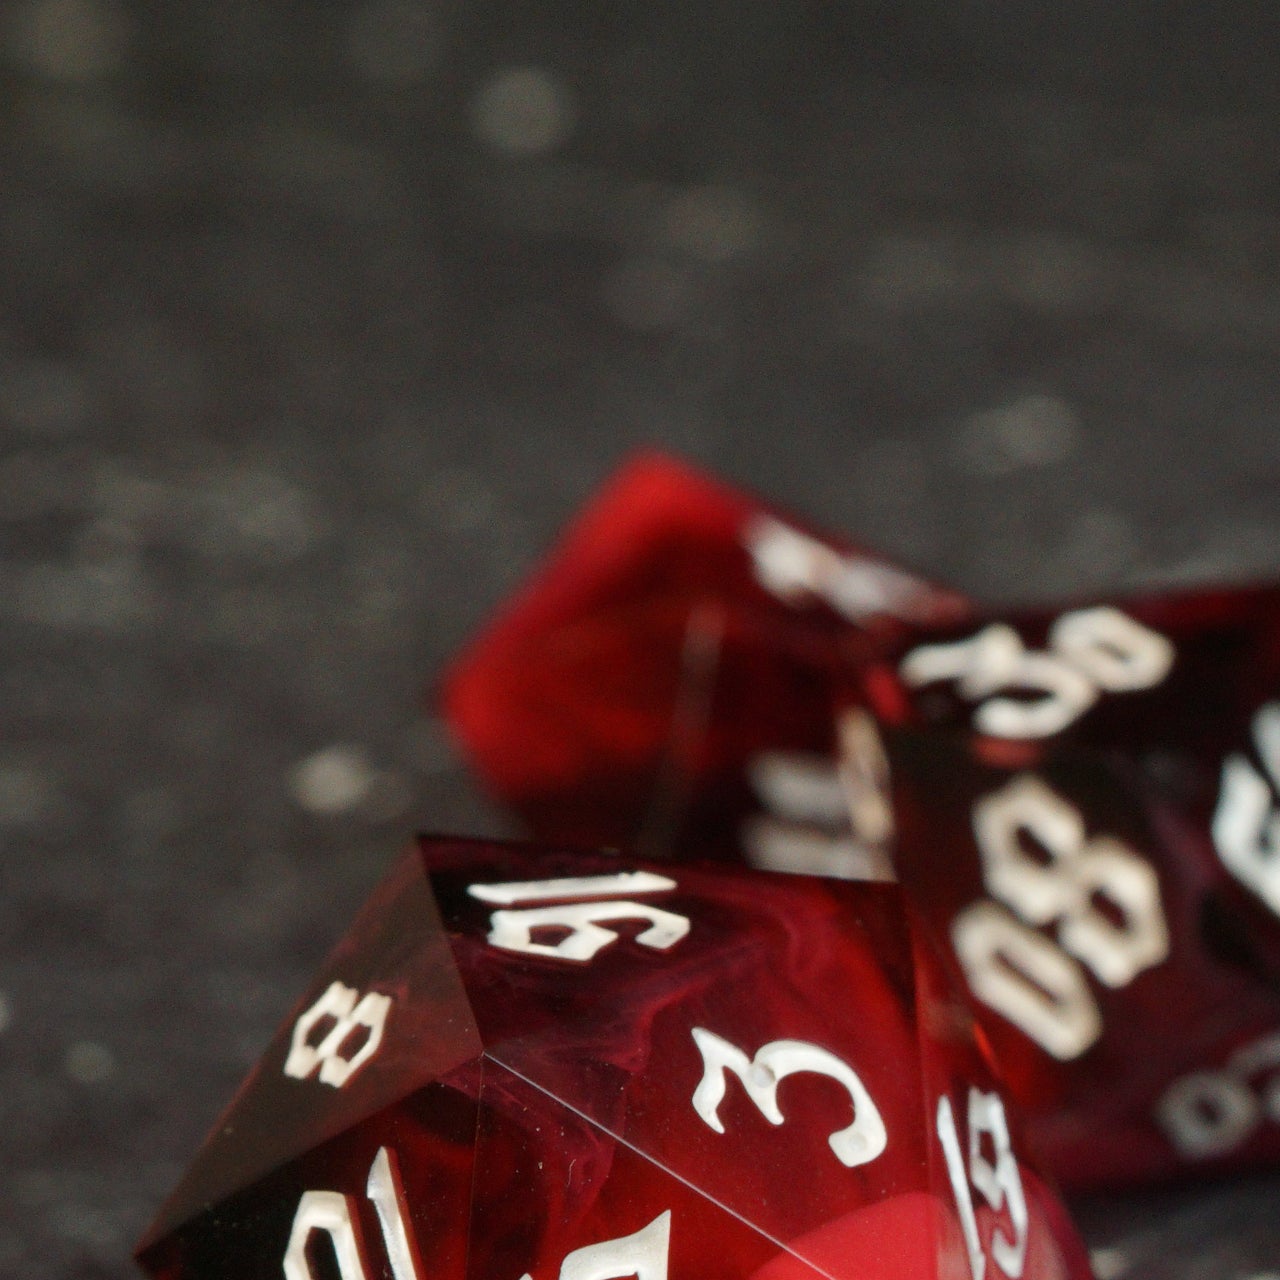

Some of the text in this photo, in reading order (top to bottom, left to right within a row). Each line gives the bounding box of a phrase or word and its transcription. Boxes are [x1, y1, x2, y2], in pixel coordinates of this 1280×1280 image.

[466, 870, 691, 963] 16
[283, 981, 392, 1089] 8
[690, 1026, 889, 1169] 3
